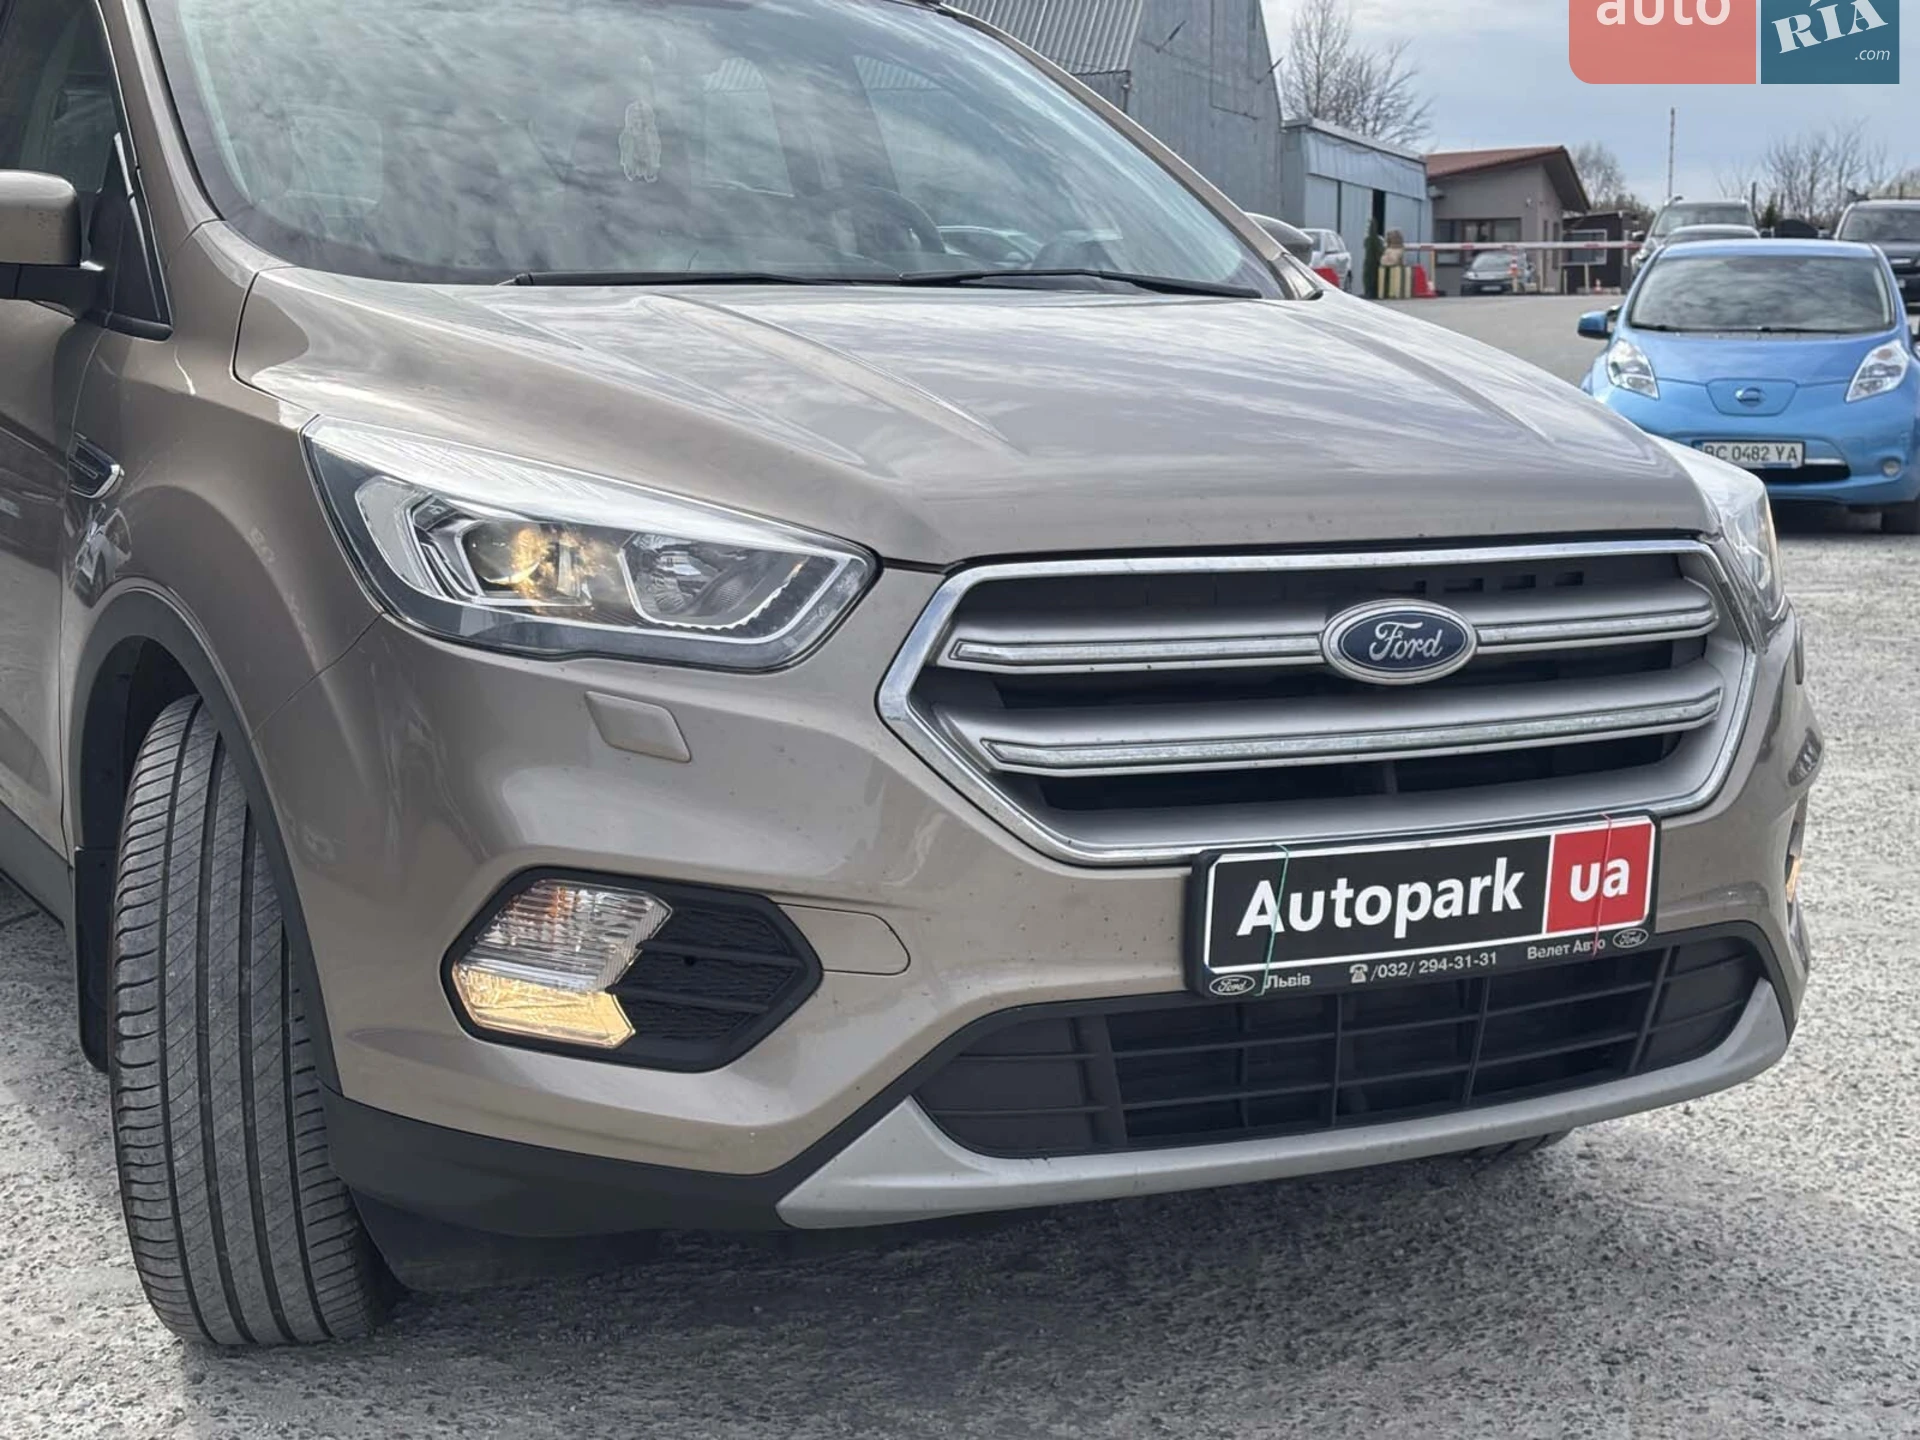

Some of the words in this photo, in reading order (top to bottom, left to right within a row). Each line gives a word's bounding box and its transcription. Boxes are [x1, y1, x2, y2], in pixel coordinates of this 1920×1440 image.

[1731, 445, 1770, 461] 0482
[1774, 446, 1798, 461] YA
[1368, 621, 1444, 661] Ford
[1236, 857, 1526, 939] Autopark
[1569, 857, 1631, 903] ua
[1619, 931, 1641, 945] Ford
[1370, 961, 1415, 982] /032/
[1418, 951, 1497, 975] 294-31-31
[1217, 979, 1248, 993] Ford
[1265, 972, 1311, 989] Львів
